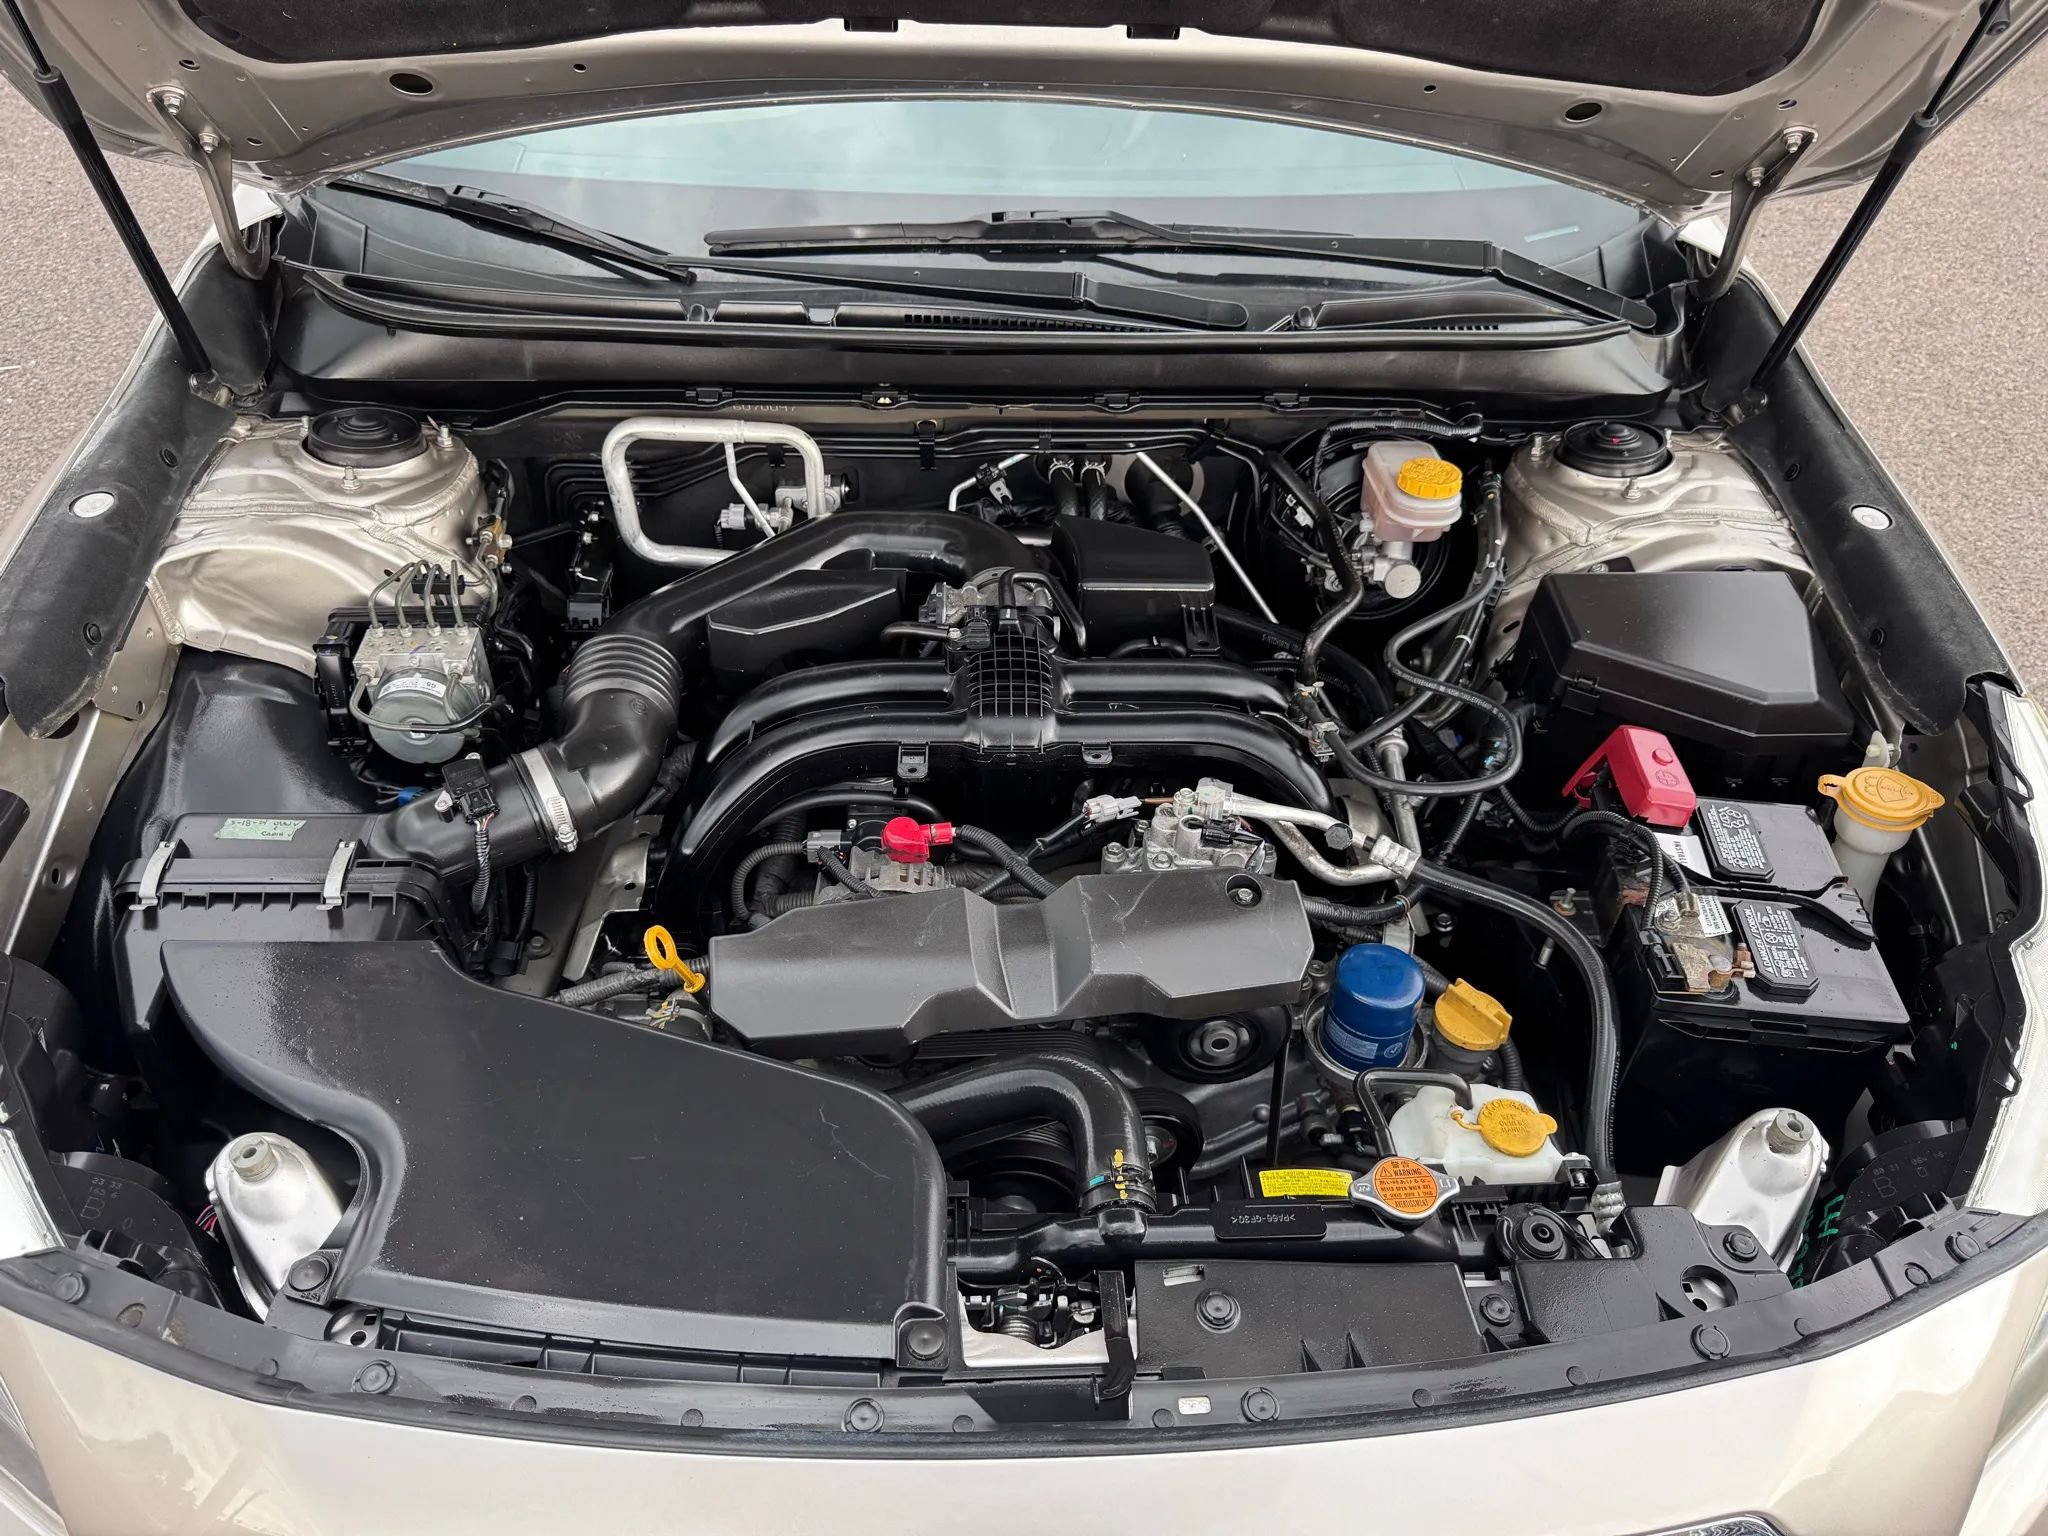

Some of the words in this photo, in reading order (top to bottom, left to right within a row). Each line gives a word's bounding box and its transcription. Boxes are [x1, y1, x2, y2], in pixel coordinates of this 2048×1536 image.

[1743, 908, 1760, 933] POISON
[1755, 938, 1772, 967] DANGER
[1393, 1168, 1422, 1177] WARNING
[1873, 1176, 1897, 1198] B
[80, 1196, 106, 1220] B
[1817, 1194, 1845, 1239] LH
